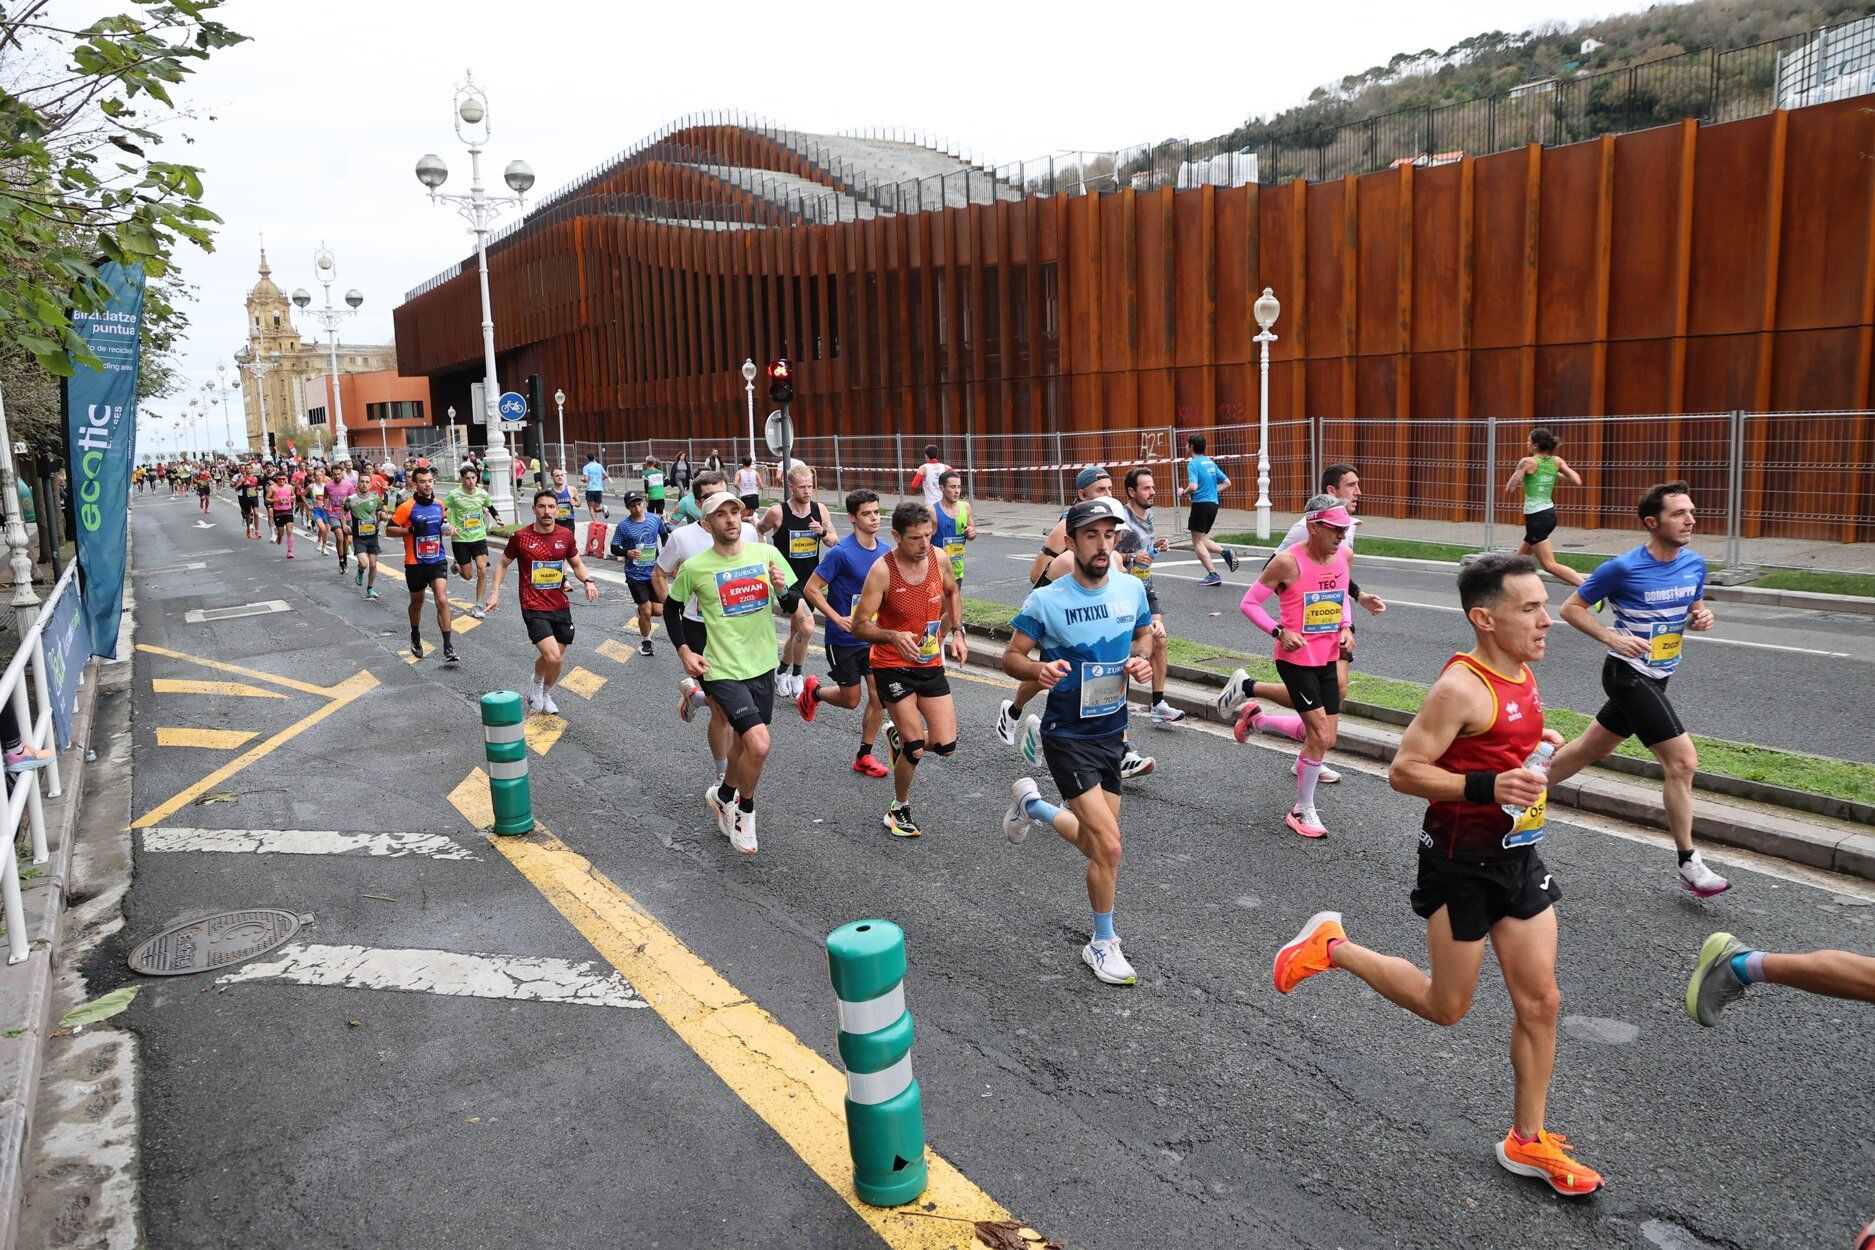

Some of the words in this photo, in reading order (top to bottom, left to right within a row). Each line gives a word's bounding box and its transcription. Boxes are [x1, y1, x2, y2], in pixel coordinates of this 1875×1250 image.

[78, 403, 112, 531] ecotic
[734, 567, 758, 578] ZURICH
[729, 582, 763, 596] ERWAN
[1318, 579, 1337, 591] TEO
[739, 594, 756, 603] 2203
[1065, 603, 1109, 626] INTXIXU
